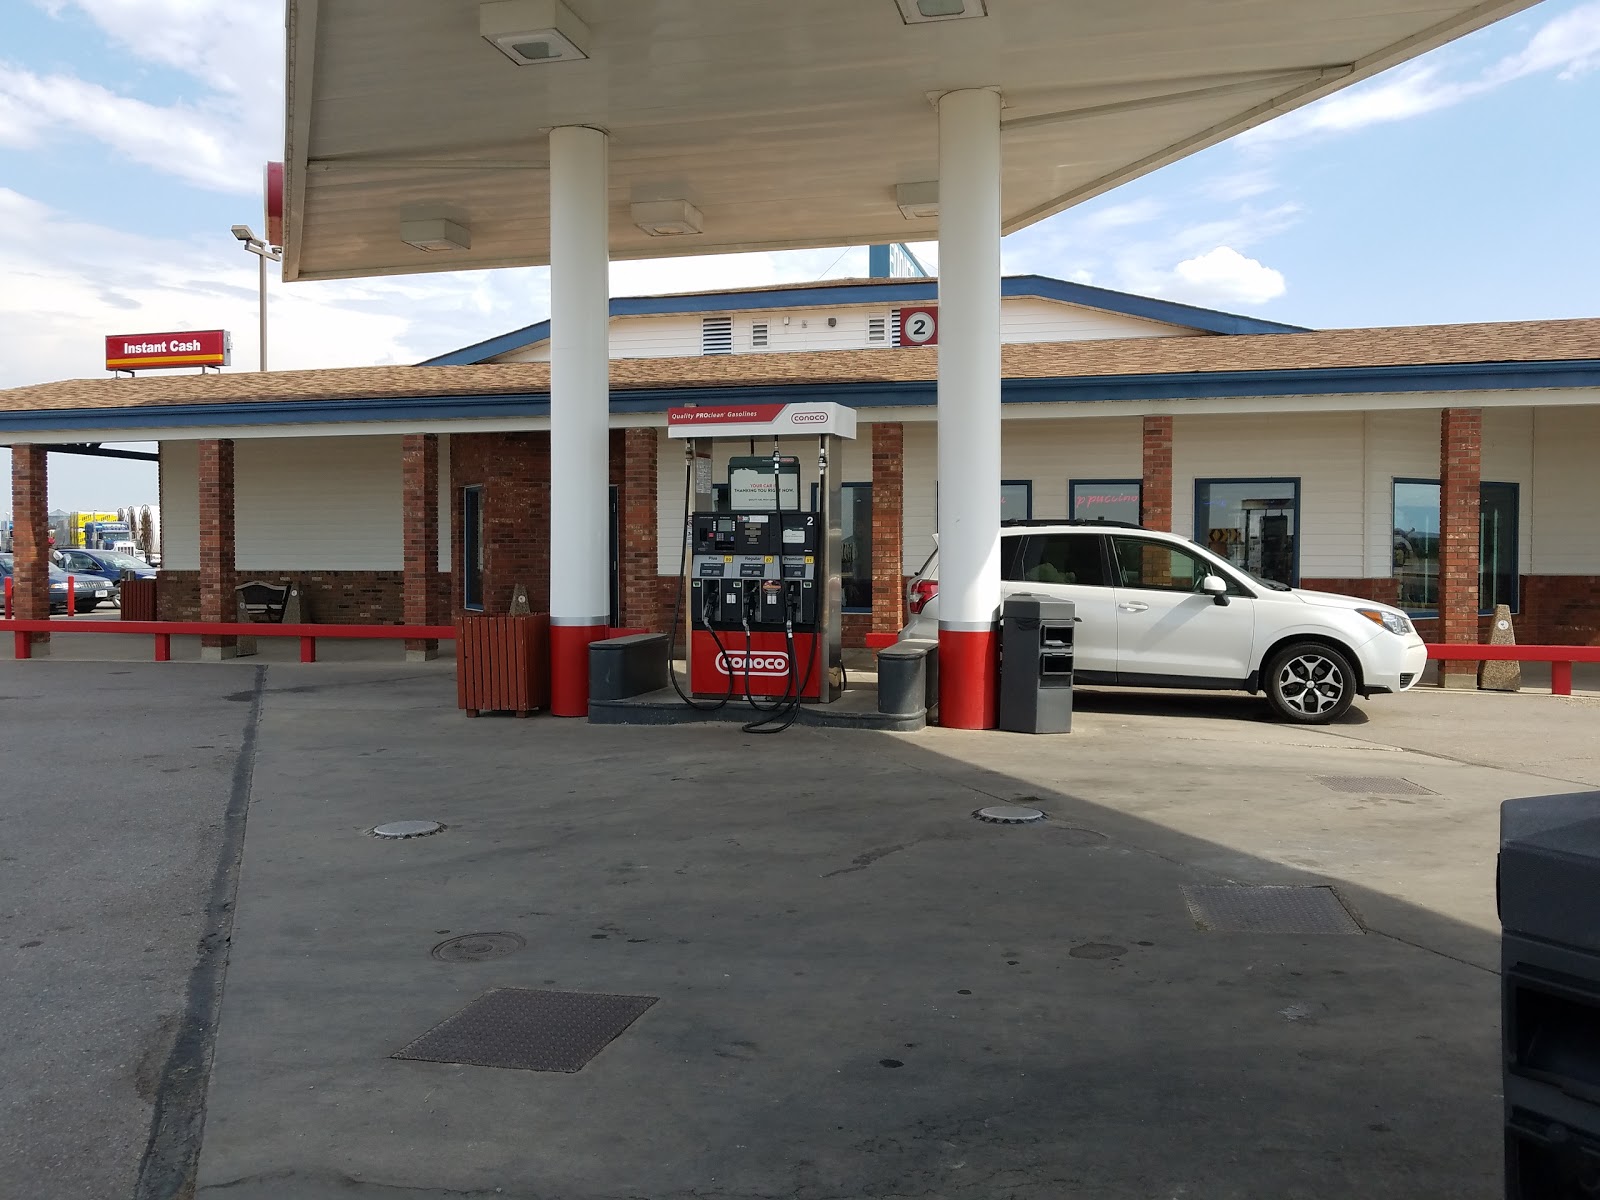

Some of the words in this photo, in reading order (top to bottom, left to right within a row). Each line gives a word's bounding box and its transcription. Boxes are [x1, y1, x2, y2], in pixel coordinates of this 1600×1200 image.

[913, 319, 926, 335] 2
[124, 341, 167, 354] Instant
[169, 339, 201, 352] Cash
[727, 410, 758, 418] Gasolines
[806, 516, 815, 526] 2
